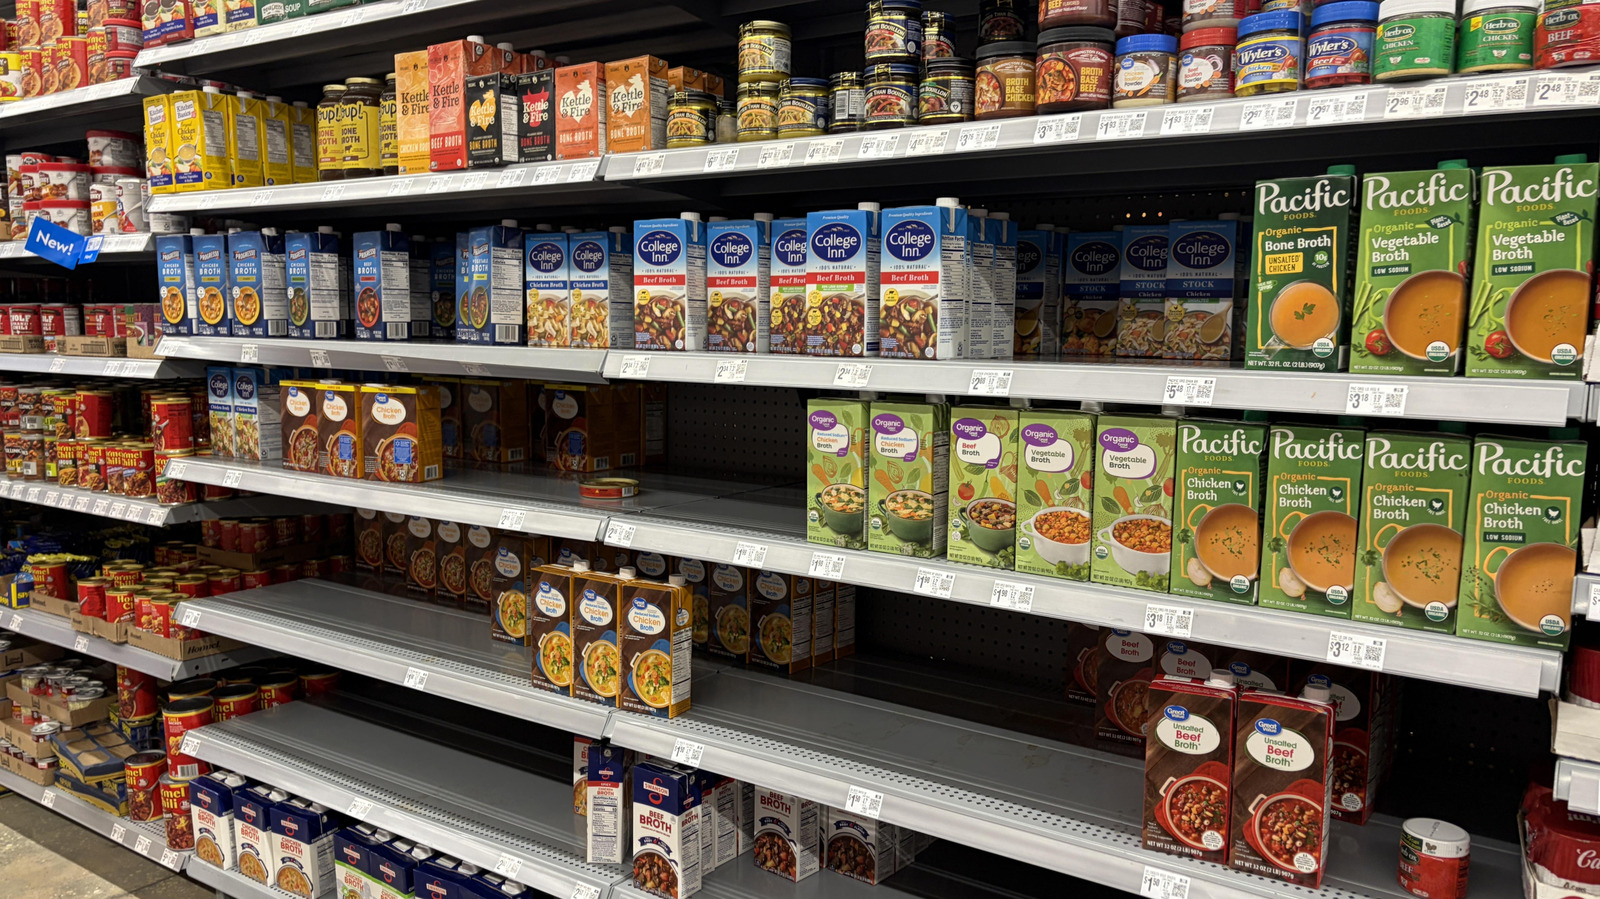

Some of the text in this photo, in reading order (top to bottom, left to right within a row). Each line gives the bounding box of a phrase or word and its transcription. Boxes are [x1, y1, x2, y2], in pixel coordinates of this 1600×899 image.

[285, 3, 301, 12] SOUP
[881, 24, 906, 36] BOUILLON
[1548, 31, 1574, 43] BEEF
[1309, 40, 1349, 56] Wyler's
[1383, 40, 1414, 50] CHICKEN
[1241, 47, 1282, 64] Wyler's
[1313, 58, 1334, 66] Beef
[1081, 68, 1102, 76] BROTH
[1006, 78, 1028, 86] BROTH
[1081, 76, 1098, 84] BASE
[432, 83, 460, 97] Kettle
[1006, 86, 1024, 94] BASE
[1080, 84, 1096, 92] BEEF
[562, 94, 591, 107] Kettle
[613, 88, 643, 102] Kettle
[1006, 94, 1034, 102] CHICKEN
[433, 97, 459, 109] & Fire
[523, 100, 549, 113] Kettle
[523, 112, 549, 123] & Fire
[431, 135, 462, 149] BEEF BROTH
[1363, 173, 1469, 210] Pacific
[1481, 167, 1597, 206] Pacific
[1255, 179, 1349, 216] Pacific
[1516, 204, 1553, 212] FOODS
[1494, 219, 1538, 232] Organic
[1265, 226, 1301, 238] Organic
[35, 229, 74, 256] New!
[815, 234, 857, 249] College
[1265, 235, 1331, 251] Bone Broth
[1372, 232, 1439, 251] Vegetable
[1492, 230, 1565, 248] Vegetable
[641, 241, 677, 254] College
[714, 243, 749, 255] College
[827, 247, 846, 258] Inn
[1177, 242, 1225, 254] College
[532, 252, 561, 262] College
[575, 251, 602, 261] College
[652, 253, 668, 262] Inn
[724, 255, 740, 264] Inn
[1075, 252, 1115, 264] College
[1191, 254, 1210, 265] Inn
[1372, 249, 1409, 262] Broth
[1493, 247, 1532, 261] Broth
[541, 262, 553, 270] Inn
[583, 261, 595, 269] Inn
[1087, 262, 1103, 272] Inn
[1269, 264, 1295, 272] CHICKEN
[816, 274, 833, 282] Beef
[909, 273, 928, 281] Broth
[237, 383, 253, 392] College
[812, 416, 834, 424] Organic
[876, 419, 901, 427] Organic
[956, 423, 983, 433] Organic
[1025, 429, 1054, 438] Organic
[1103, 434, 1134, 444] Organic
[1178, 425, 1263, 455] Pacific
[1270, 429, 1363, 462] Pacific
[1031, 450, 1065, 458] Vegetable
[1110, 455, 1147, 464] Vegetable
[1366, 438, 1467, 472] Pacific
[1109, 462, 1130, 470] Broth
[1474, 442, 1585, 479] Pacific
[1188, 467, 1221, 477] Organic
[1281, 472, 1316, 483] Organic
[1187, 478, 1231, 489] Chicken
[1279, 484, 1327, 496] Chicken
[1187, 491, 1217, 501] Broth
[1374, 495, 1426, 507] Chicken
[1486, 491, 1528, 501] Organic
[1279, 498, 1312, 508] Broth
[1374, 509, 1409, 520] Broth
[1484, 503, 1541, 516] Chicken
[1484, 517, 1523, 529] Broth
[540, 600, 562, 609] Chicken
[584, 607, 608, 617] Chicken
[633, 615, 661, 626] Chicken
[640, 624, 654, 632] Broth
[1121, 639, 1139, 650] Beef
[1167, 707, 1185, 716] Great
[1173, 723, 1204, 733] Unsalted
[1258, 721, 1277, 730] Great
[1176, 730, 1201, 742] Beef
[1265, 737, 1297, 749] Unsalted
[1267, 745, 1294, 758] Beef
[645, 783, 668, 795] SWANSON
[770, 791, 783, 800] BEEF
[760, 796, 791, 814] BROTH
[198, 814, 216, 827] BROTH
[649, 810, 664, 820] BEEF
[639, 815, 672, 833] BROTH
[241, 828, 260, 842] BROTH
[281, 837, 302, 847] CHICKEN
[280, 841, 303, 855] BROTH
[344, 877, 364, 891] BROTH
